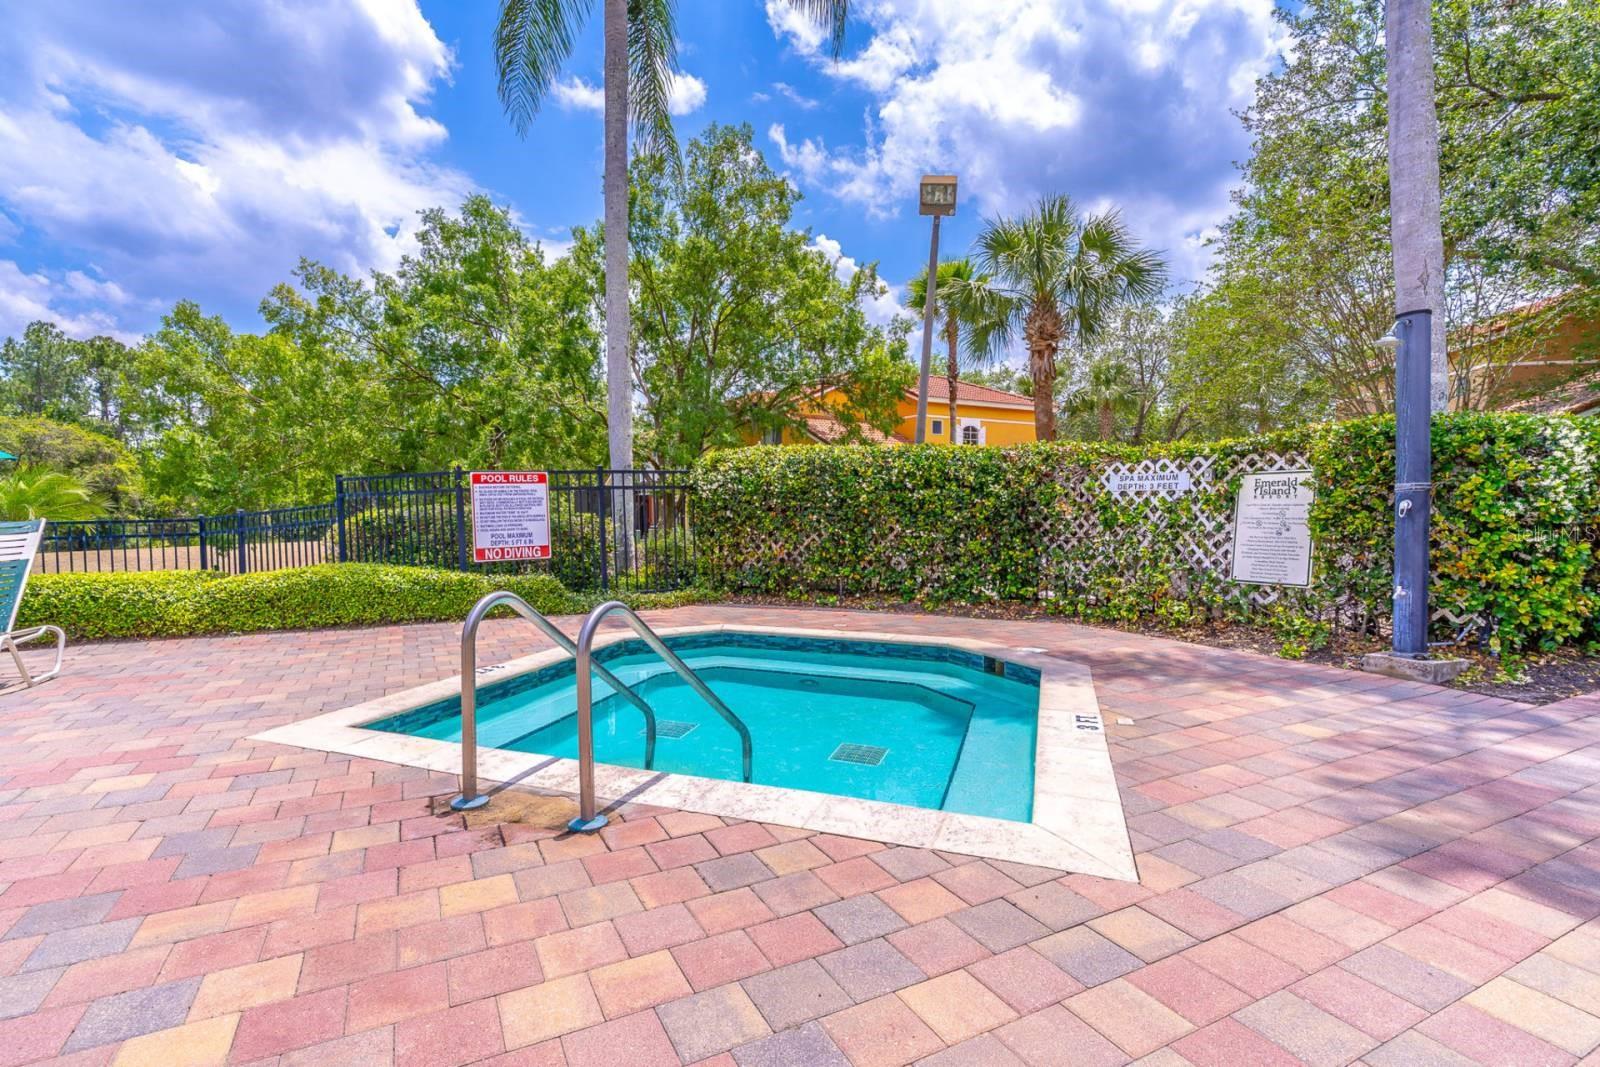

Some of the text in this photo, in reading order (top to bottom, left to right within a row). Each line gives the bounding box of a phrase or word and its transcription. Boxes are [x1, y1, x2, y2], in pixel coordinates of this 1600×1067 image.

[480, 474, 539, 483] POOL RULES
[1254, 477, 1298, 487] Emerald
[1117, 483, 1147, 491] DEPTH:
[1156, 482, 1179, 490] FEET
[1259, 485, 1291, 496] Island
[490, 531, 533, 540] POOL MAXIMUM
[485, 546, 542, 560] NO DIVING
[1075, 715, 1099, 724] FT
